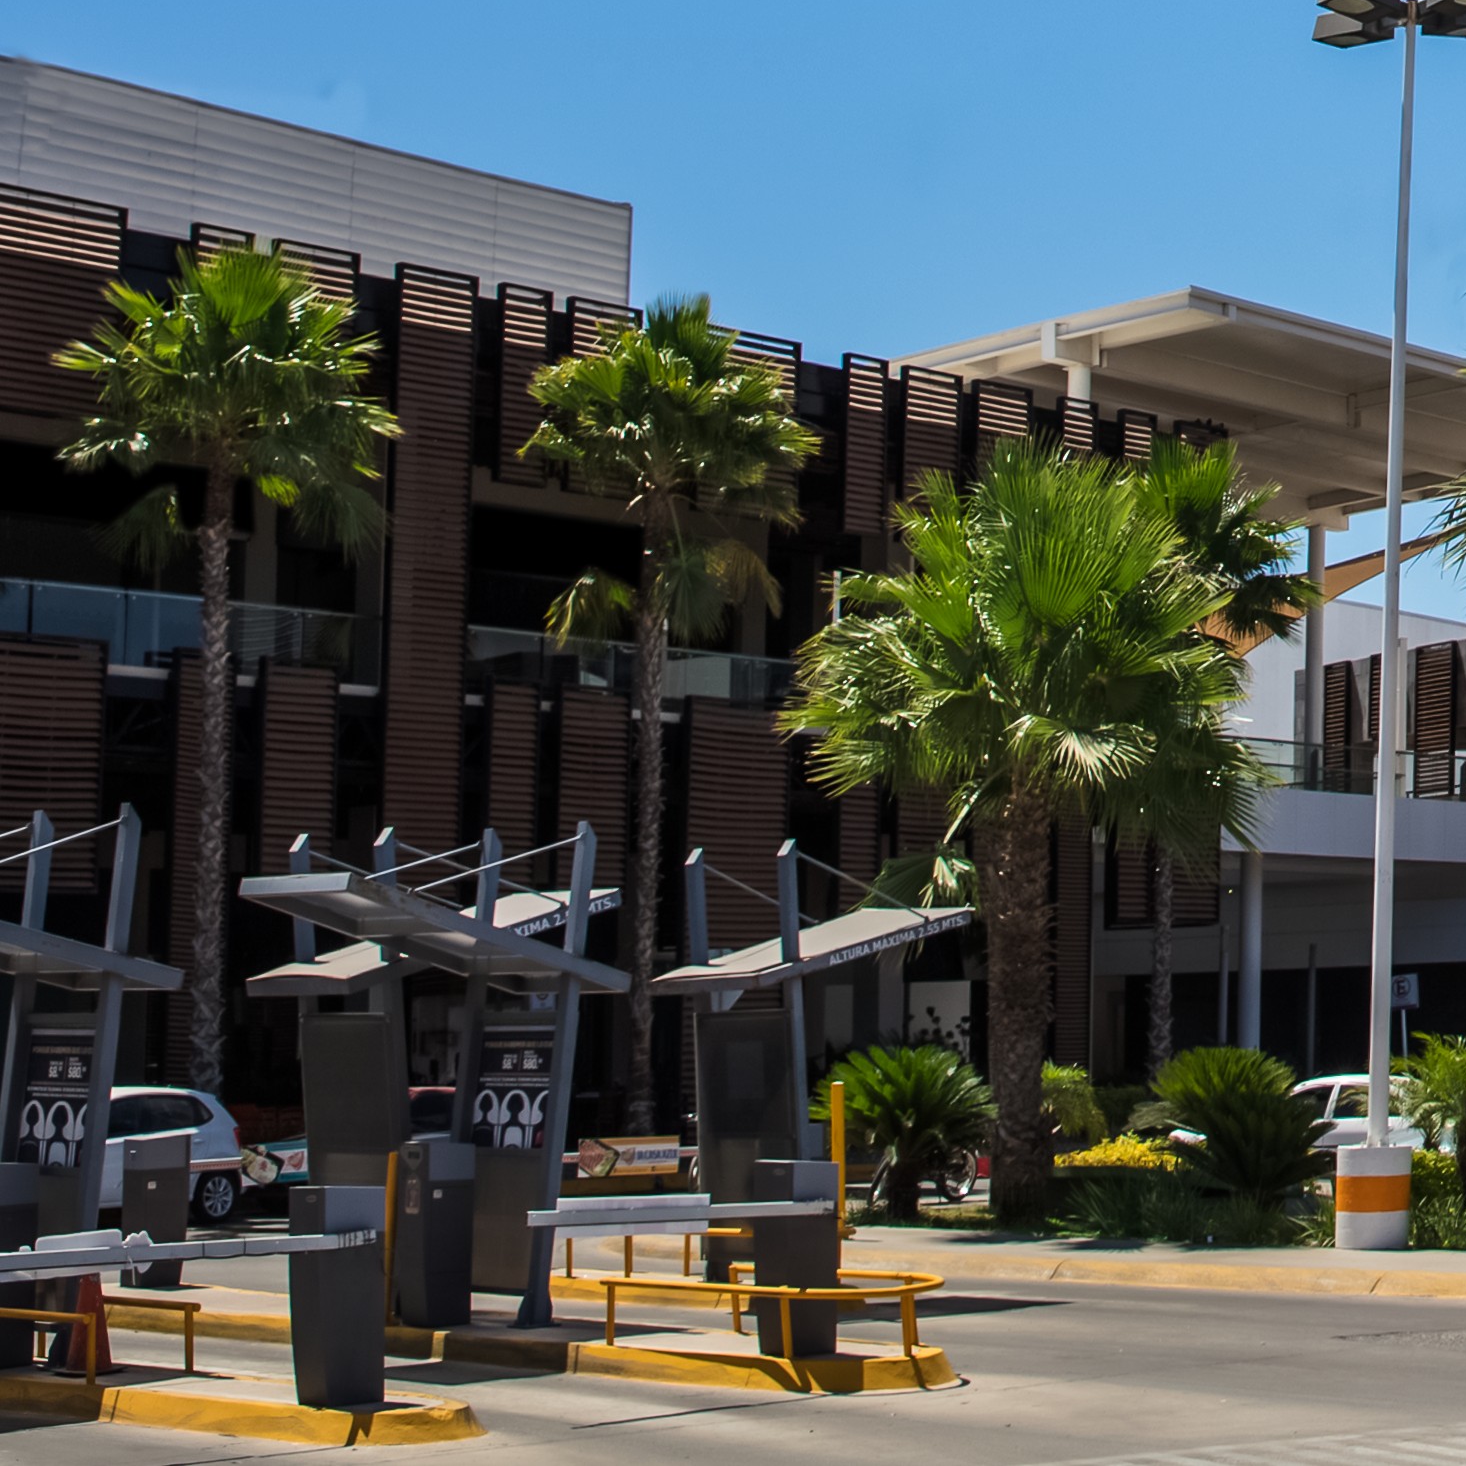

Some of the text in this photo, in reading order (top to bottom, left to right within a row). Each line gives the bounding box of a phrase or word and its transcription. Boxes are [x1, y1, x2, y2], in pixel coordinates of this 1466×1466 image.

[829, 945, 871, 965] ALTURA
[918, 922, 940, 938] 2.55
[942, 914, 967, 931] MTS.
